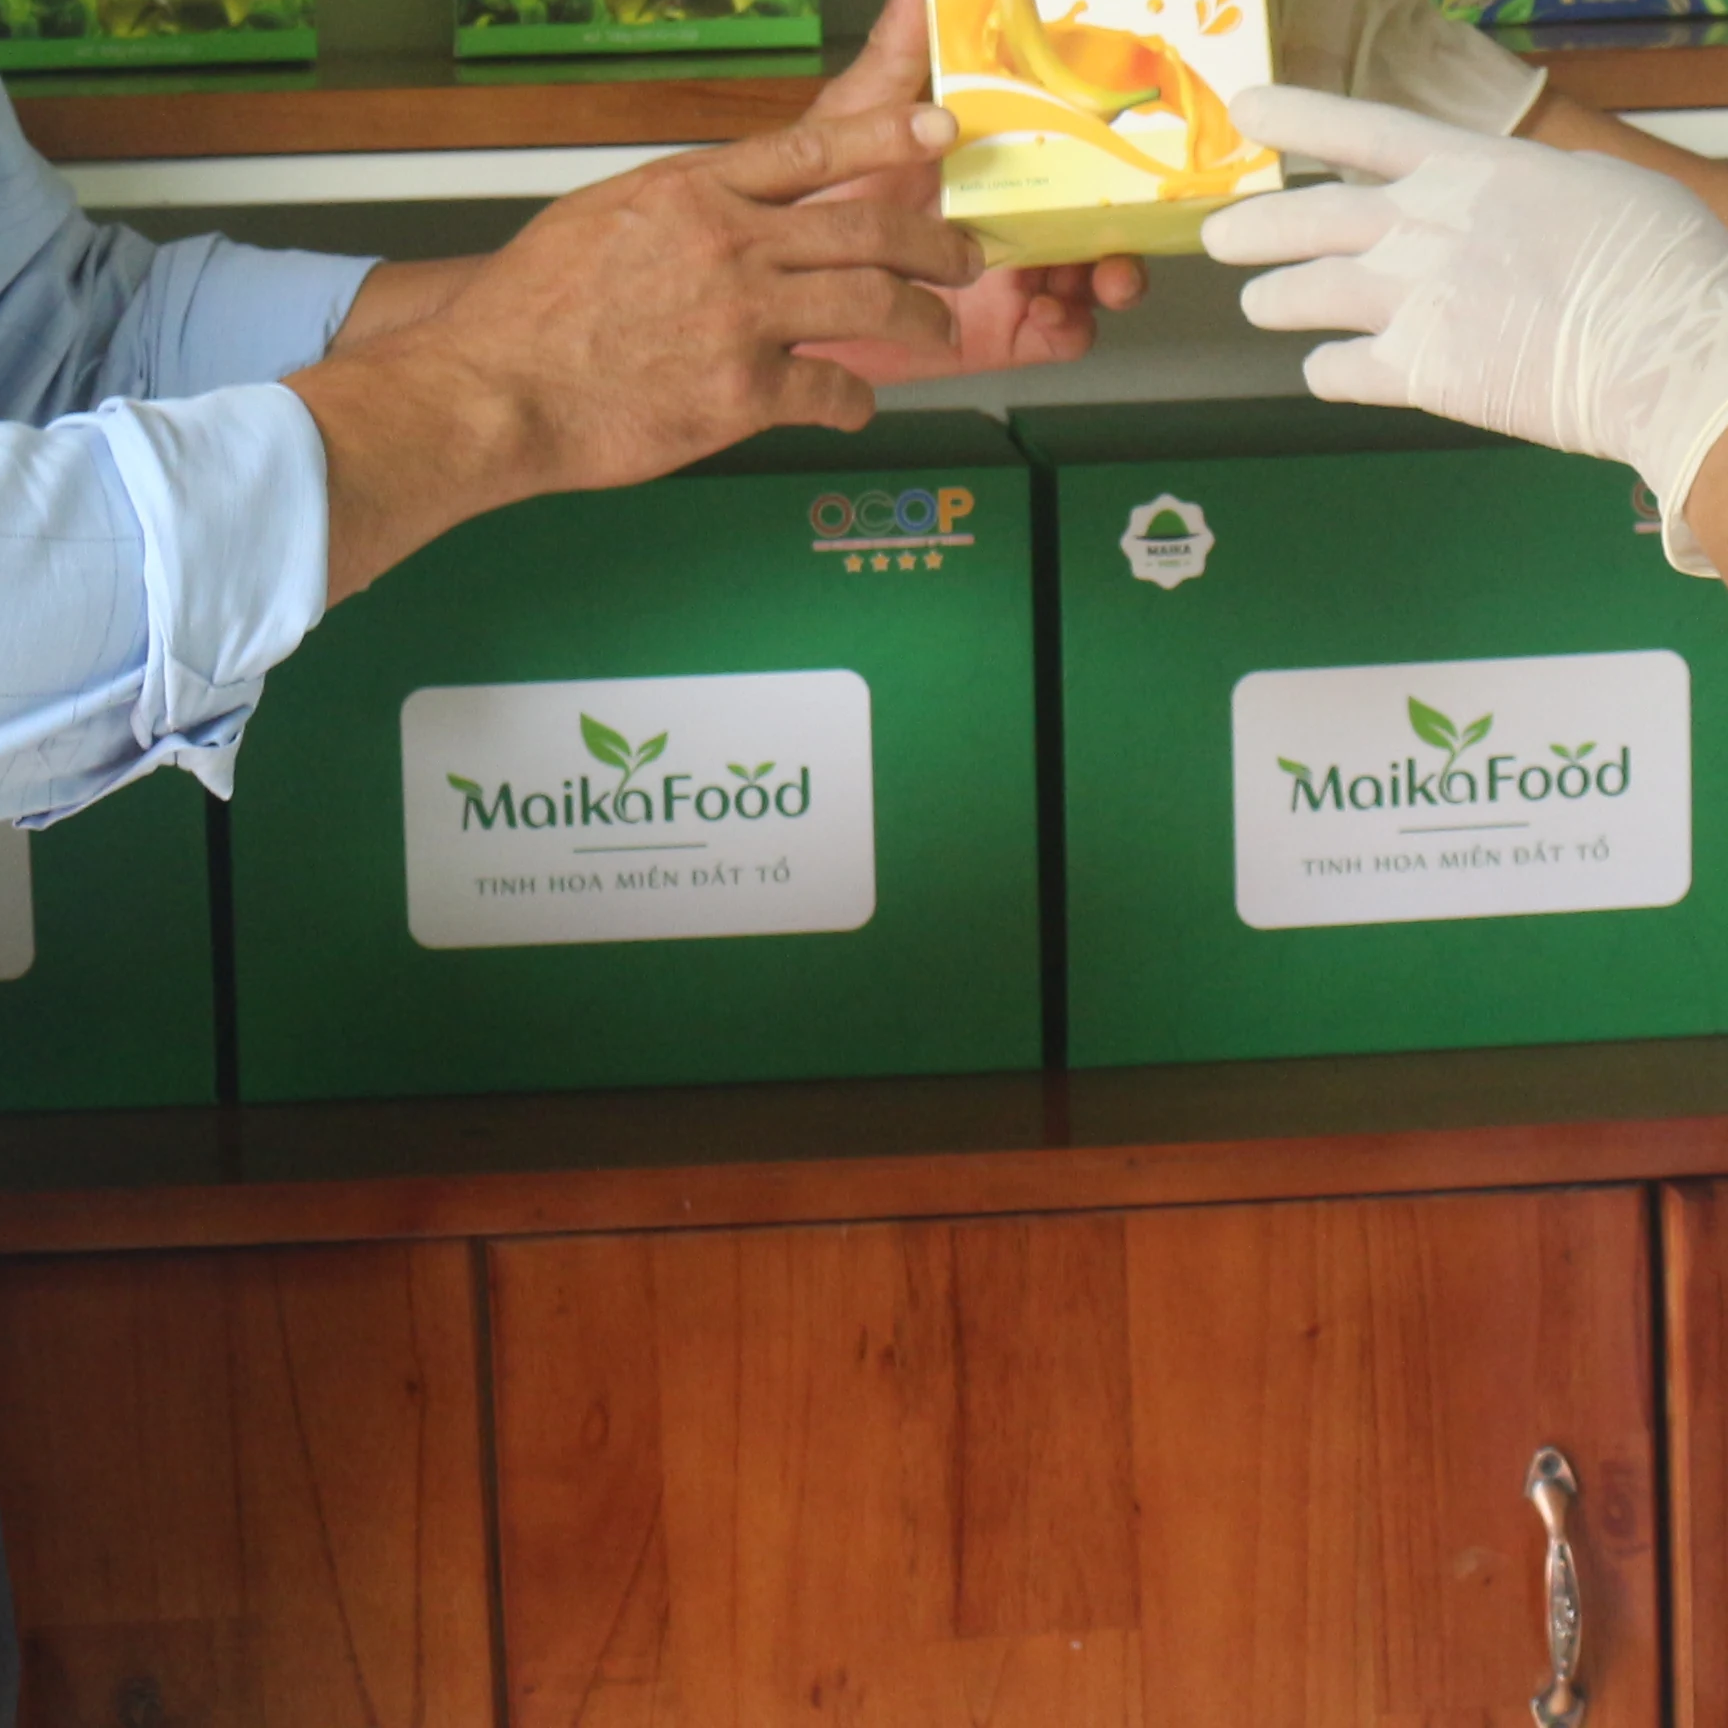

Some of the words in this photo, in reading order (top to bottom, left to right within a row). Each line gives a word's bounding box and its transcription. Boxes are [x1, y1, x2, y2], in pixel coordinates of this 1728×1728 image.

[810, 486, 974, 538] OCOP
[462, 765, 811, 833] MaikaFood
[1290, 745, 1631, 814] MaikaFood
[476, 876, 536, 898] TINH
[549, 874, 603, 894] HOA
[1302, 856, 1362, 877] TINH
[1374, 854, 1427, 873] HOA
